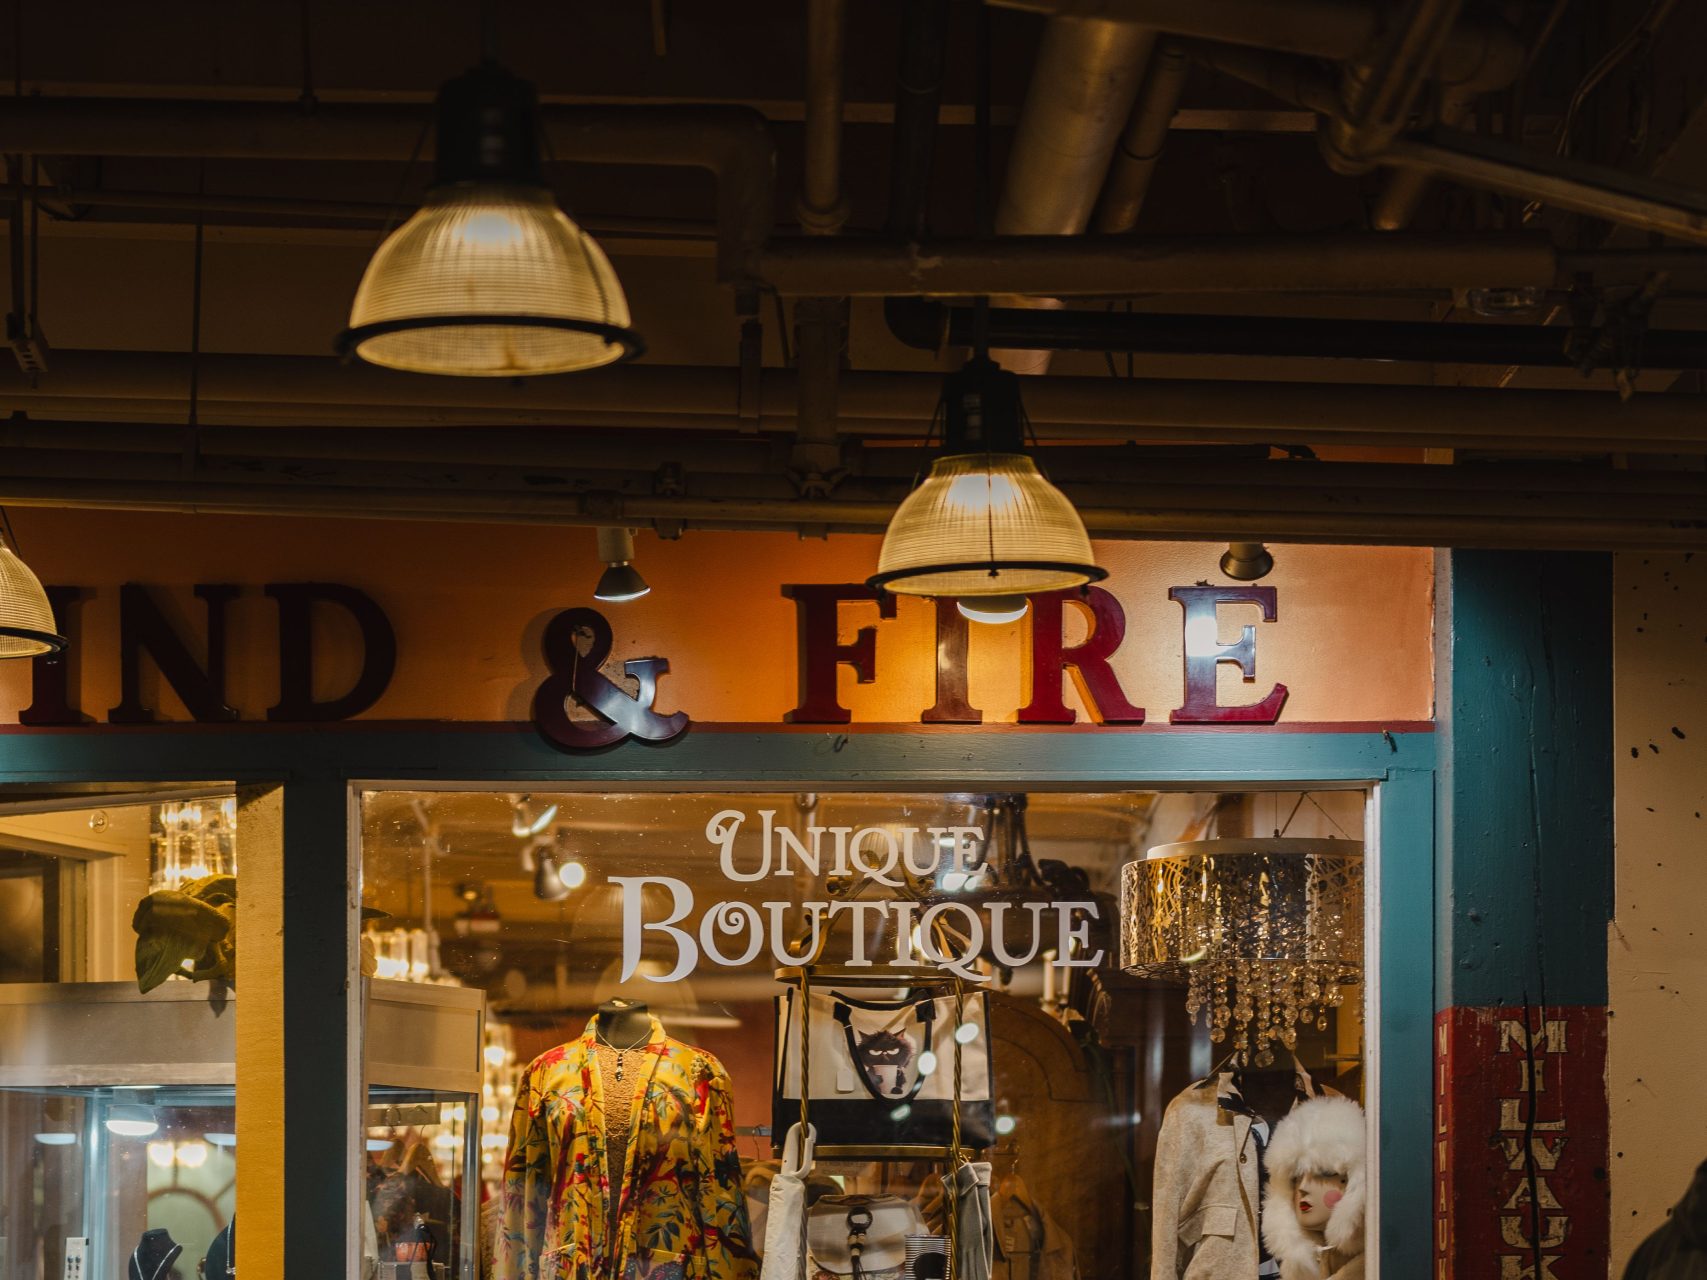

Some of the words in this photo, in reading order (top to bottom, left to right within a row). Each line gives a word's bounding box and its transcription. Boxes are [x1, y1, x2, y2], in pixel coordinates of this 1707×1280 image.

[533, 607, 688, 749] &
[780, 583, 1289, 725] FIRE
[705, 809, 989, 887] UNIQUE
[607, 876, 1104, 983] BOUTIQUE
